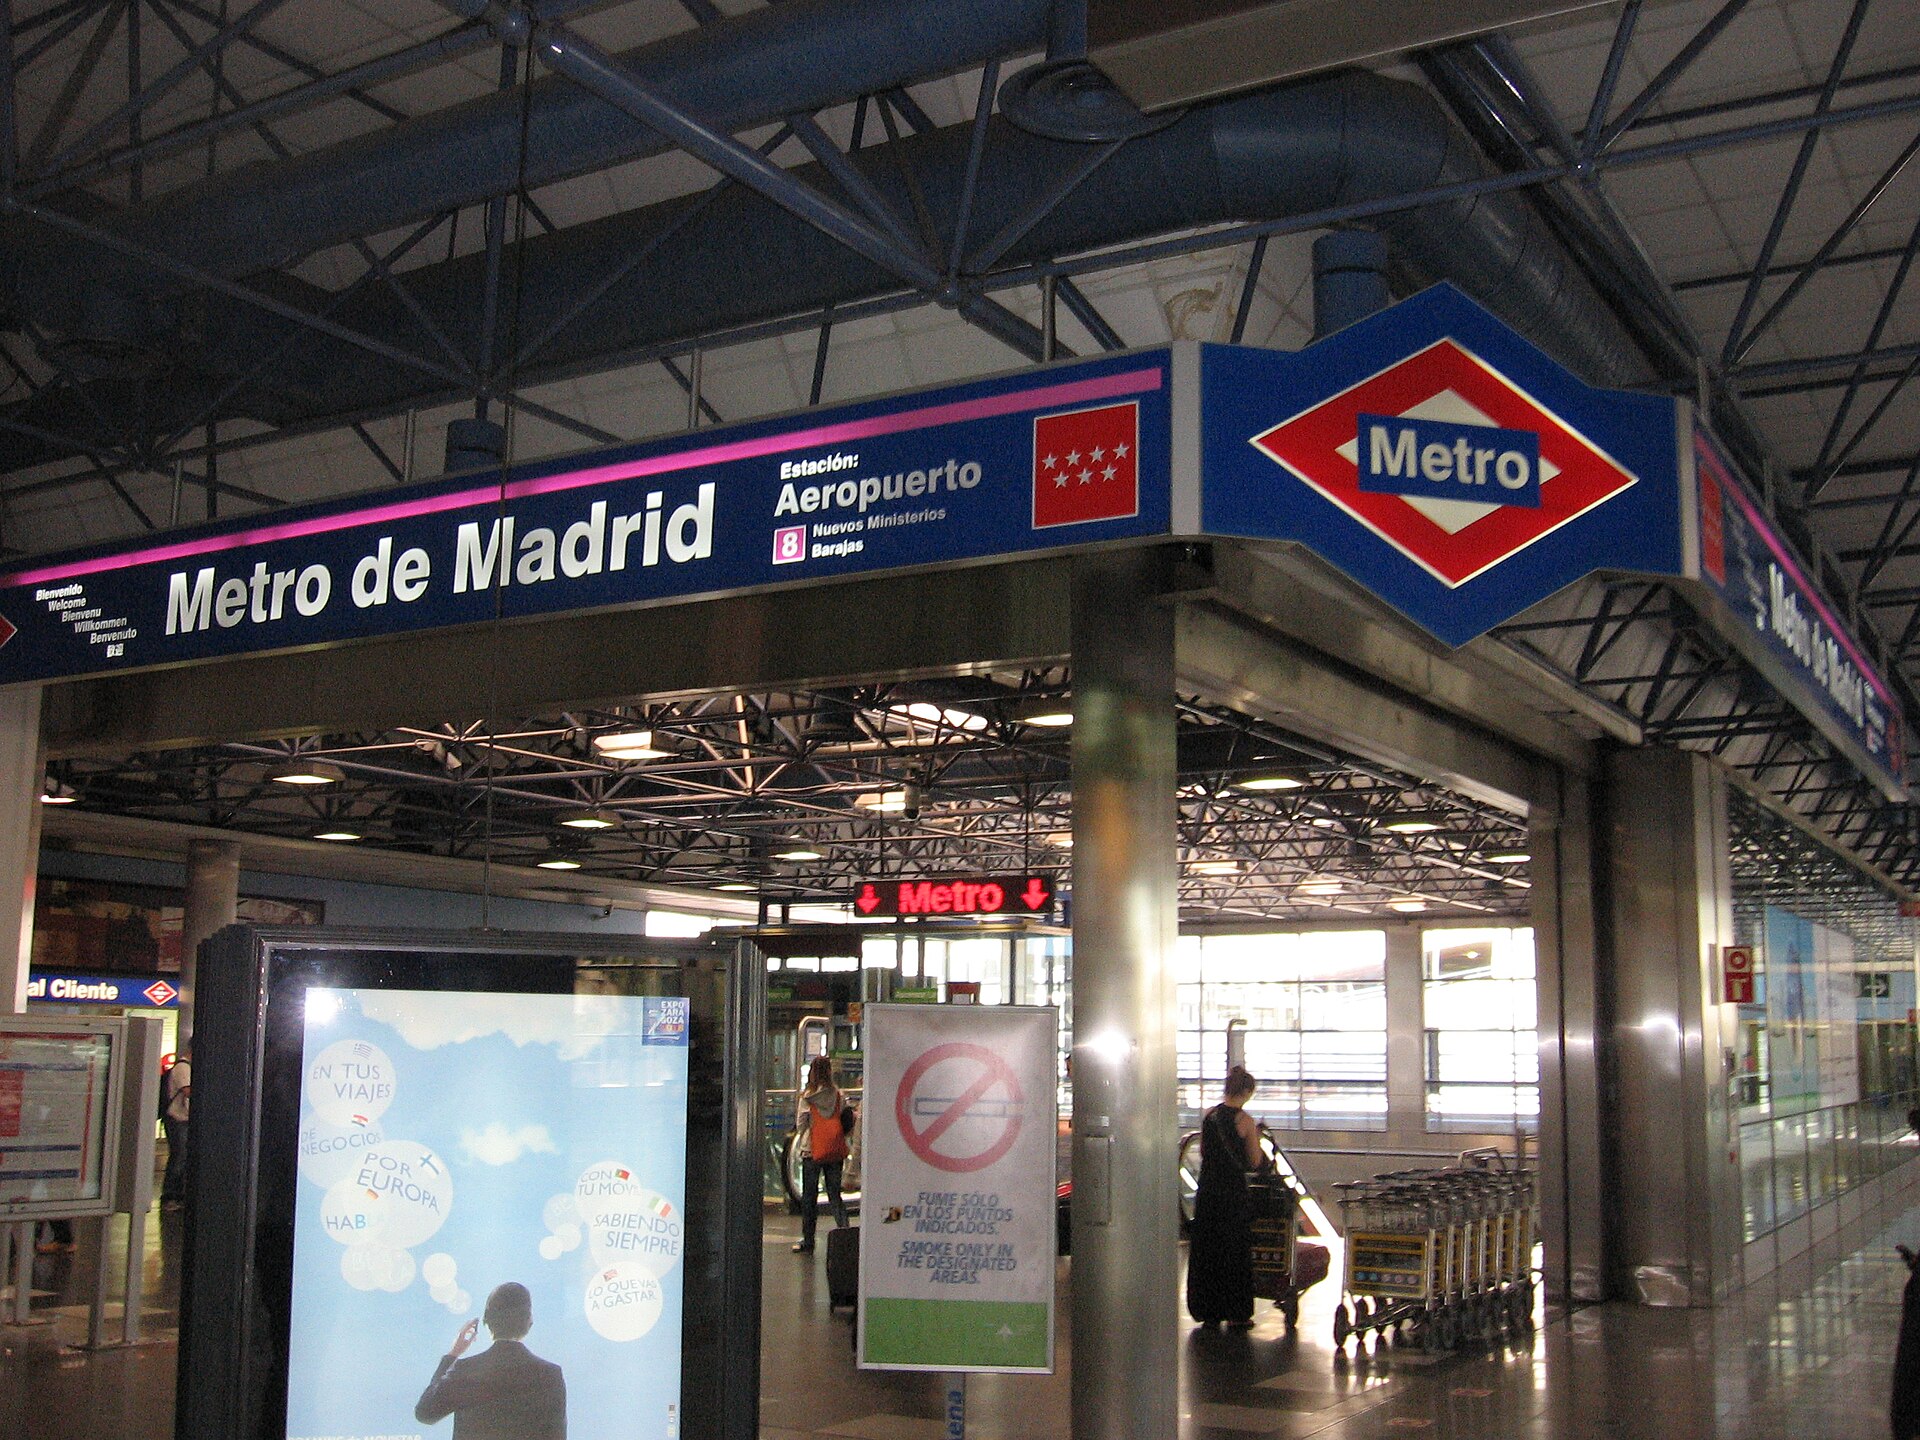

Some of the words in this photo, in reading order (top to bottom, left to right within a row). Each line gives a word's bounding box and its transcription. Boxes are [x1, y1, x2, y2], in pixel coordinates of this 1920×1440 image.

[780, 453, 859, 480] Estación:
[1369, 425, 1531, 490] Metro
[774, 459, 982, 517] Aeropuerto
[812, 520, 864, 538] Nuevos
[867, 508, 947, 530] Ministerios
[781, 532, 799, 558] 8
[811, 539, 864, 558] Barajas
[165, 561, 331, 635] Metro
[350, 537, 430, 608] de
[453, 481, 717, 594] Madrid
[35, 583, 83, 601] Bienvenido
[48, 597, 87, 612] Welcome
[62, 608, 102, 622] Bienvenu
[75, 617, 127, 633] Willkommen
[90, 628, 137, 644] Benvenuto
[898, 880, 1005, 914] Metro
[27, 977, 46, 997] al
[50, 978, 119, 1000] Cliente
[660, 1000, 684, 1009] EXPO
[313, 1064, 332, 1081] EN
[342, 1063, 380, 1081] TUS
[333, 1082, 391, 1104] VIAJES
[300, 1131, 382, 1156] NEGOCIOS
[364, 1152, 412, 1179] POR
[580, 1170, 612, 1183] CON
[356, 1168, 441, 1217] EUROPA
[579, 1183, 595, 1196] TU
[916, 1191, 957, 1206] FUME
[902, 1205, 923, 1219] EN
[925, 1207, 953, 1220] LOS
[956, 1208, 1014, 1222] PUNTOS
[593, 1213, 680, 1238] SABIENDO
[915, 1220, 999, 1235] INDICADOS.
[606, 1230, 679, 1256] SIEMPRE
[901, 1241, 952, 1256] SMOKE
[956, 1243, 995, 1257] ONLY
[997, 1244, 1015, 1258] IN
[897, 1254, 923, 1269] THE
[926, 1256, 1018, 1271] DESIGNATED
[608, 1279, 639, 1294] QUE
[929, 1270, 981, 1284] AREAS.
[592, 1300, 600, 1311] A
[603, 1290, 658, 1308] GASTAR
[948, 1390, 963, 1440] ena
